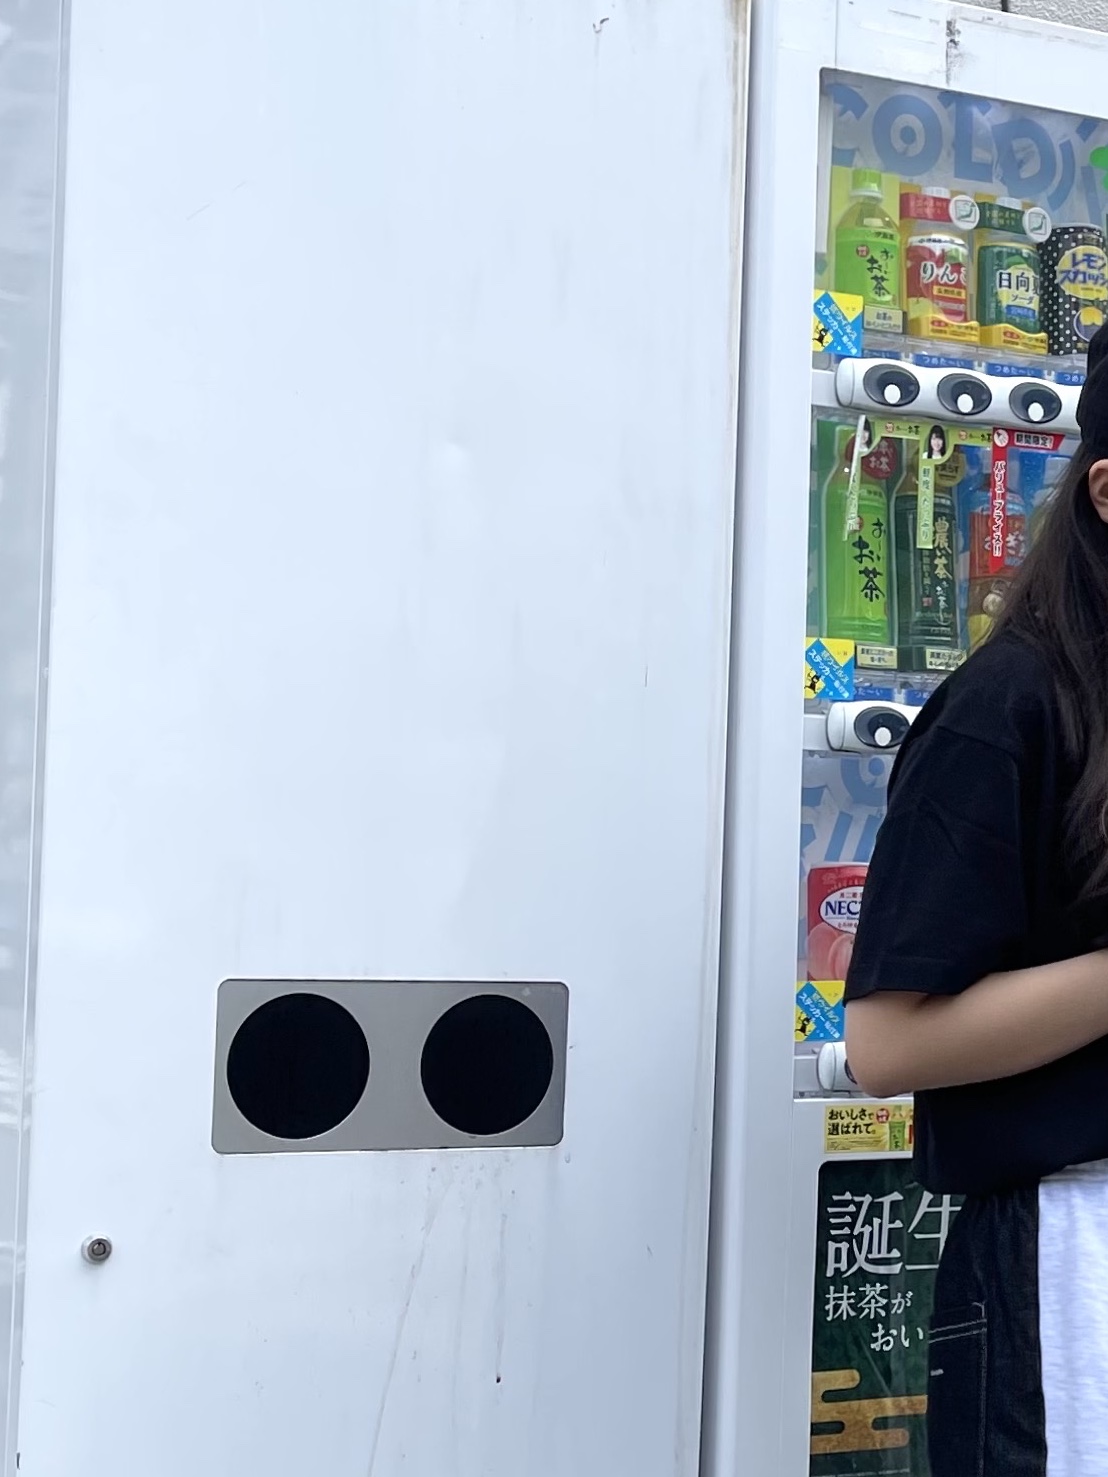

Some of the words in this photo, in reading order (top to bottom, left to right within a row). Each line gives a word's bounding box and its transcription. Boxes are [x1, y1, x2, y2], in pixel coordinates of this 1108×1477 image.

[852, 535, 885, 603] お茶
[824, 900, 862, 917] NEC
[828, 1107, 875, 1121] おいしさで
[825, 1190, 963, 1280] 誕生
[824, 1282, 914, 1322] 抹茶が
[869, 1323, 926, 1353] おい
